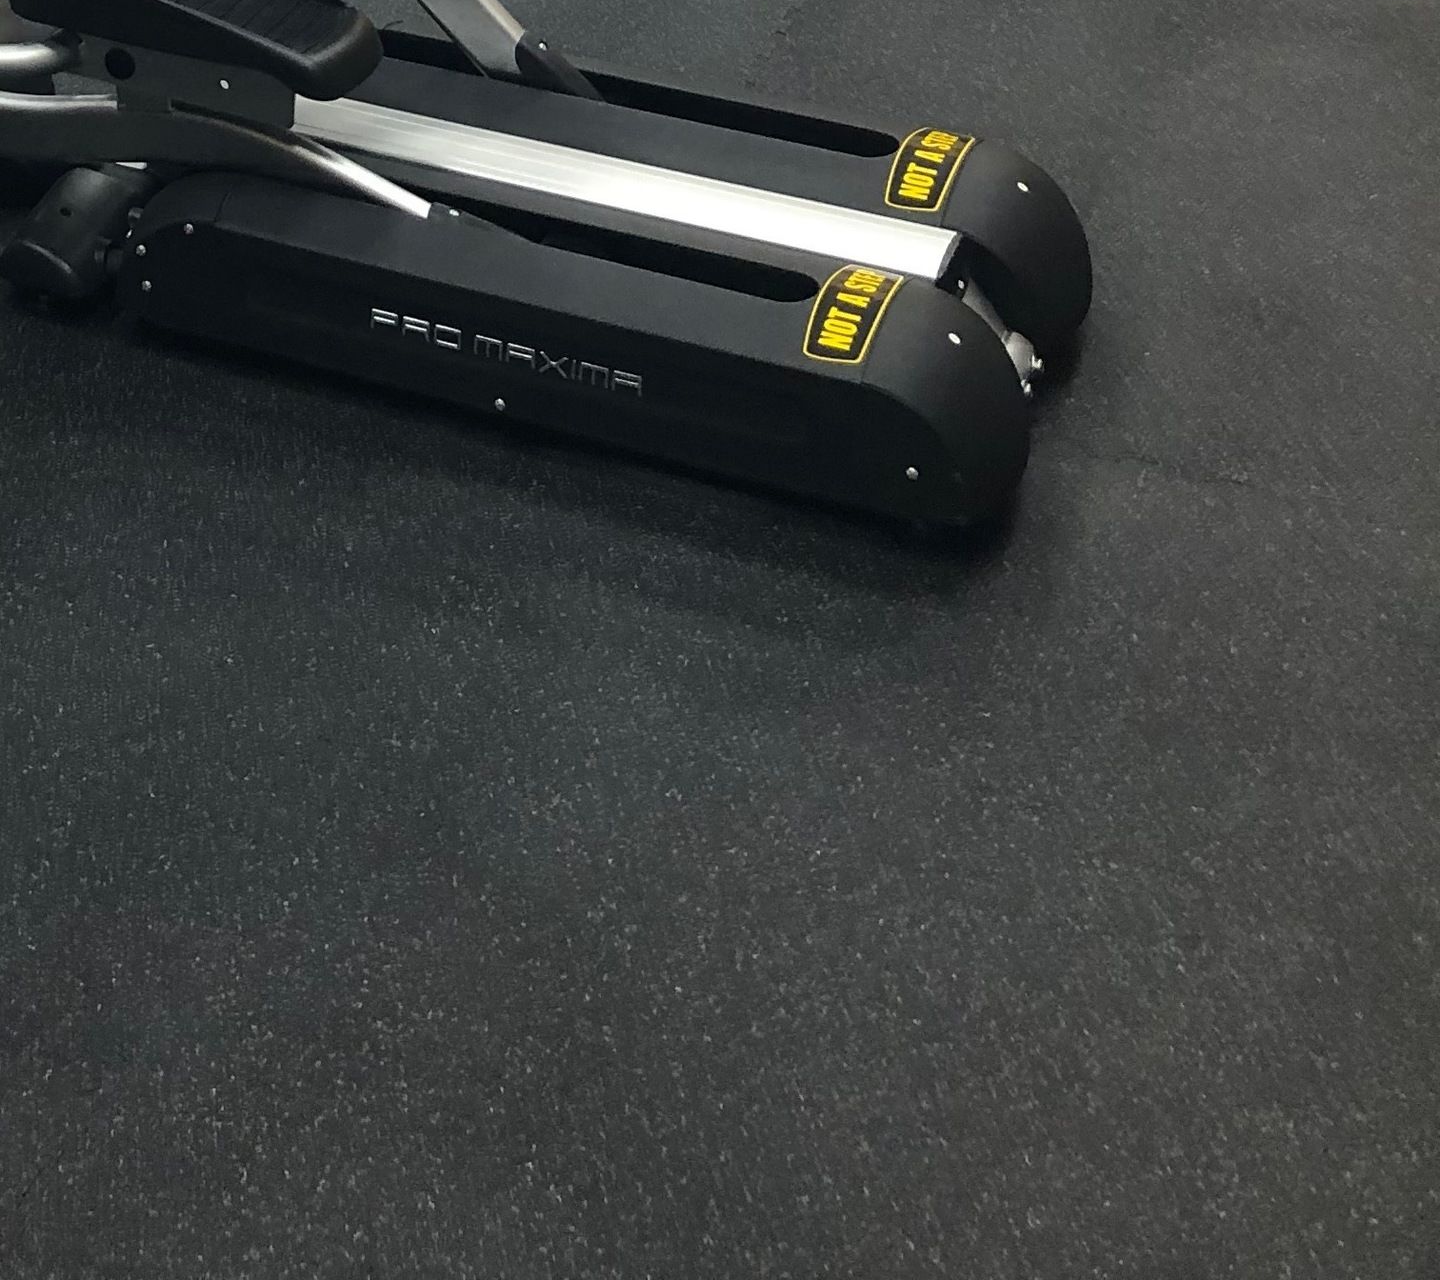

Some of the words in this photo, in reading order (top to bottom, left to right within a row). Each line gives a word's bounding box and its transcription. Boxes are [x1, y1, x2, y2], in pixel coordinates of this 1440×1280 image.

[914, 149, 946, 163] A
[898, 162, 939, 201] NOT
[836, 292, 871, 308] A
[818, 306, 862, 351] NOT
[370, 307, 462, 351] PRO
[473, 333, 643, 397] MAXIMA
